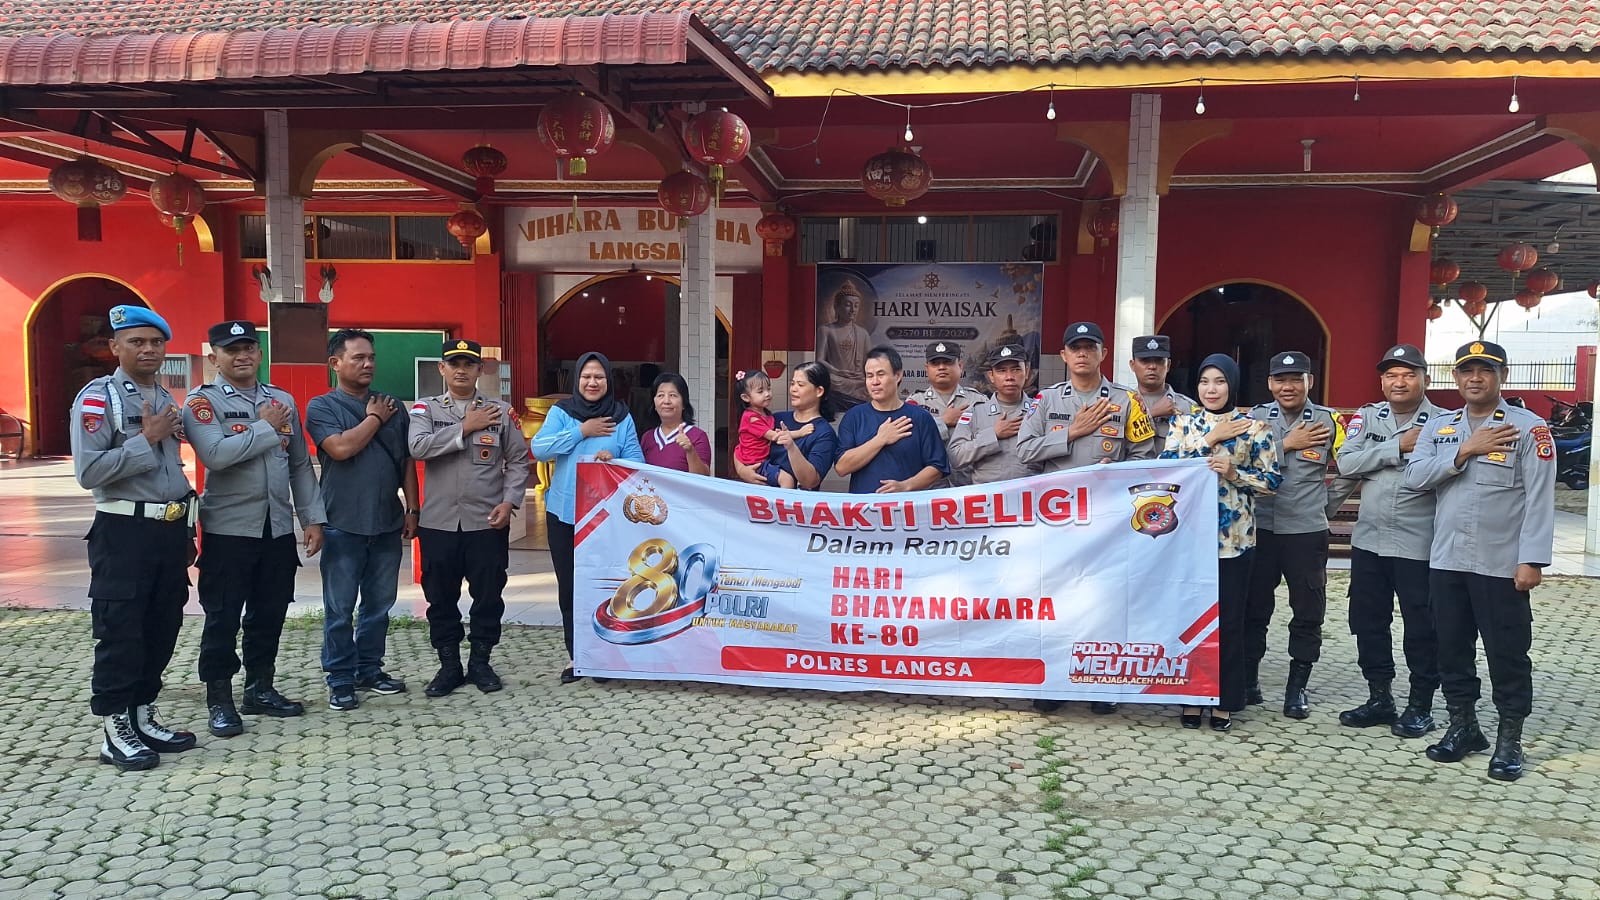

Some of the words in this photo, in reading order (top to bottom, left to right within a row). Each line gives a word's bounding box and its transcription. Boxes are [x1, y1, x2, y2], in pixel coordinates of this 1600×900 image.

[518, 209, 622, 242] VIHARA
[638, 209, 751, 246] BUHA
[589, 241, 681, 261] LANGSA
[873, 301, 919, 317] HARI
[924, 301, 998, 318] WAISAK
[897, 329, 920, 338] 2570
[922, 329, 936, 338] BE
[945, 329, 969, 338] 2026
[1133, 484, 1176, 493] ACEH
[746, 495, 918, 530] BHAKTI
[930, 486, 1089, 528] RELIGI
[807, 533, 893, 555] Dalam
[903, 534, 1011, 561] Rangka
[609, 537, 719, 619] 80
[720, 575, 749, 588] Tahun
[832, 566, 903, 590] HARI
[704, 593, 770, 618] POLRI
[830, 594, 1056, 621] BHAYANGKARA
[691, 617, 726, 628] UNTUK
[830, 623, 919, 647] KE-80
[1072, 641, 1119, 656] POLDA
[1120, 643, 1160, 657] ACEH
[786, 653, 869, 673] POLRES
[880, 659, 974, 678] LANGSA
[1069, 656, 1189, 678] MEUTUAH
[1097, 676, 1129, 685] TAJAGA
[1130, 677, 1154, 685] ACEH
